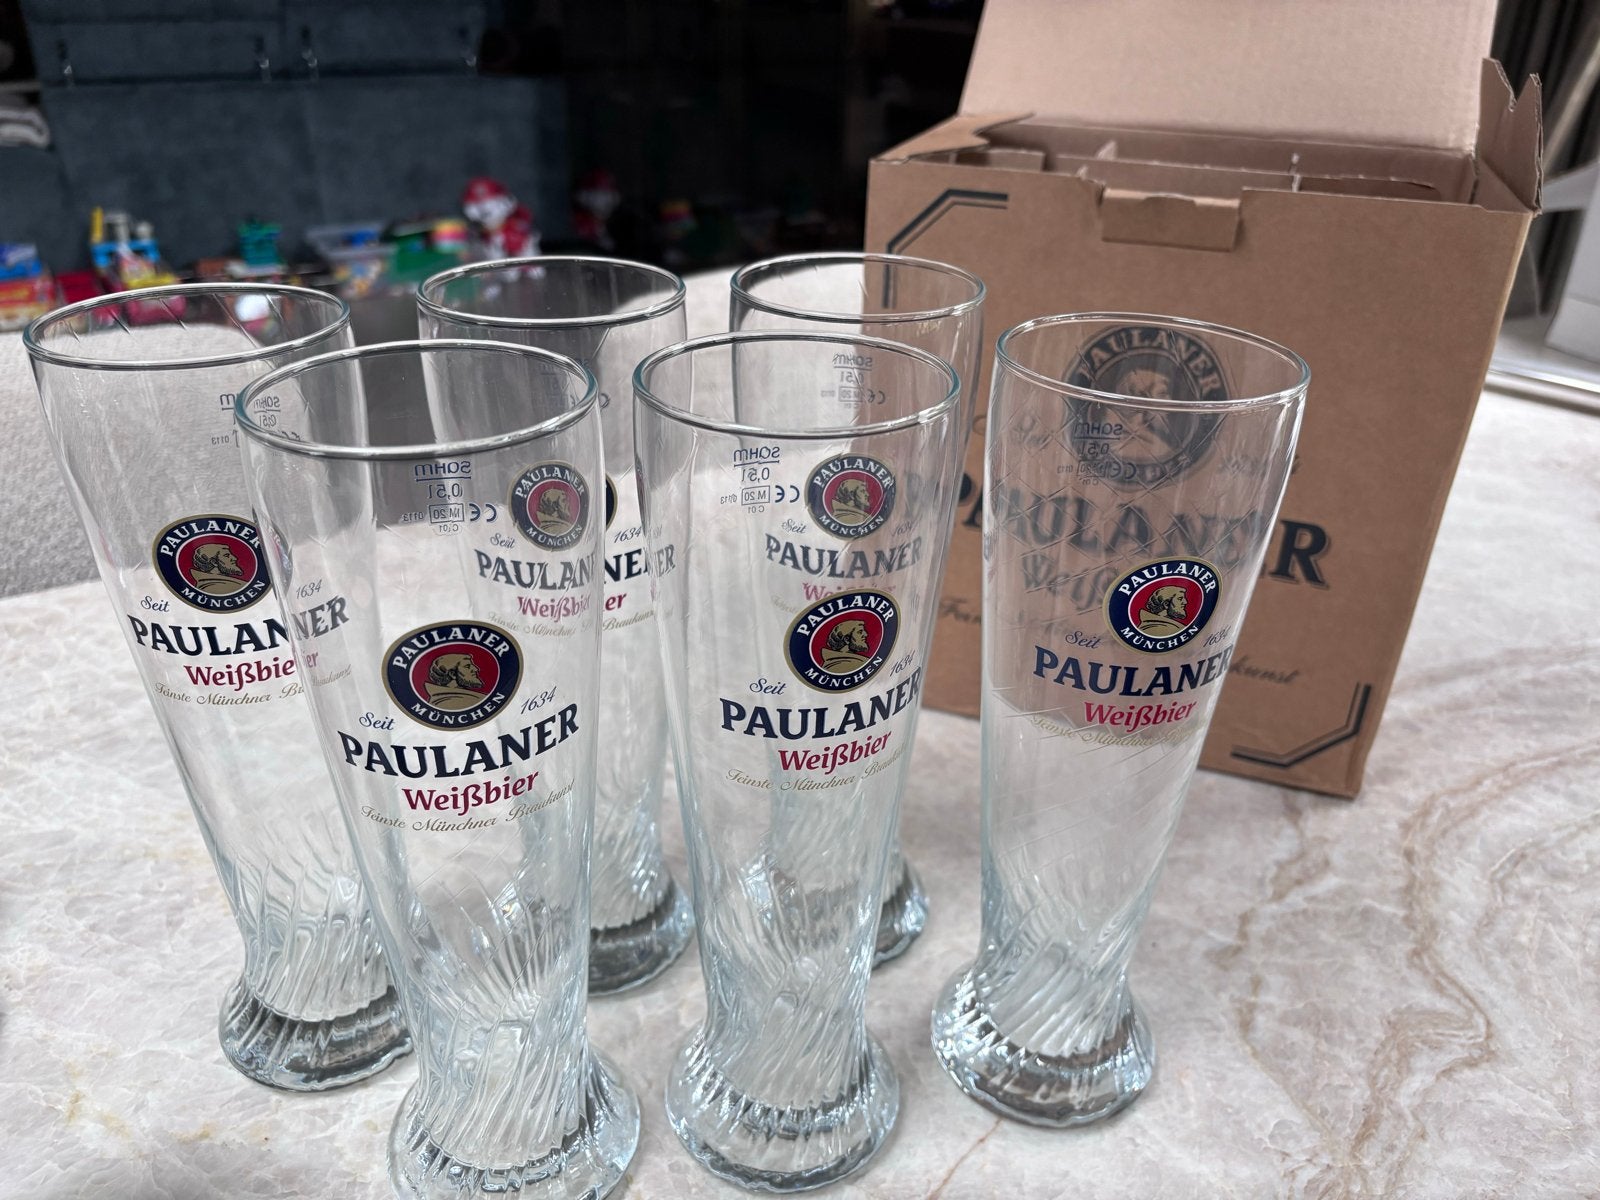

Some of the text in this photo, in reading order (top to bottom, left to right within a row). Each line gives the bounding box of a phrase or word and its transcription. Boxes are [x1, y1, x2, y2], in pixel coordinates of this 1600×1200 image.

[515, 466, 585, 499] PAULANER
[812, 458, 894, 490] PAULANER
[764, 533, 922, 580] PAULANER
[181, 580, 266, 609] MÜNCHEN
[1118, 561, 1218, 597] PAULANER
[140, 595, 170, 613] Seit
[797, 595, 894, 637] PAULANER
[393, 626, 511, 671] PAULANER
[1064, 629, 1101, 650] Seit
[1119, 624, 1201, 652] MÜNCHEN
[749, 649, 916, 696] Seit 1634
[804, 656, 884, 688] MÜNCHEN
[1033, 644, 1234, 698] PAULANER
[155, 682, 191, 703] Feinste
[196, 692, 272, 706] Münchner
[358, 686, 557, 732] Seit 1634
[410, 691, 506, 726] MÜNCHEN
[719, 666, 922, 740] PAULANER
[1083, 701, 1197, 733] Weißbier
[338, 702, 580, 779] PAULANER
[778, 731, 893, 775] Weißbier
[402, 771, 539, 816] Weißbier
[725, 768, 773, 791] Feinste
[780, 775, 856, 792] Münchner
[360, 804, 406, 829] Feinste
[411, 816, 497, 832] Münchner
